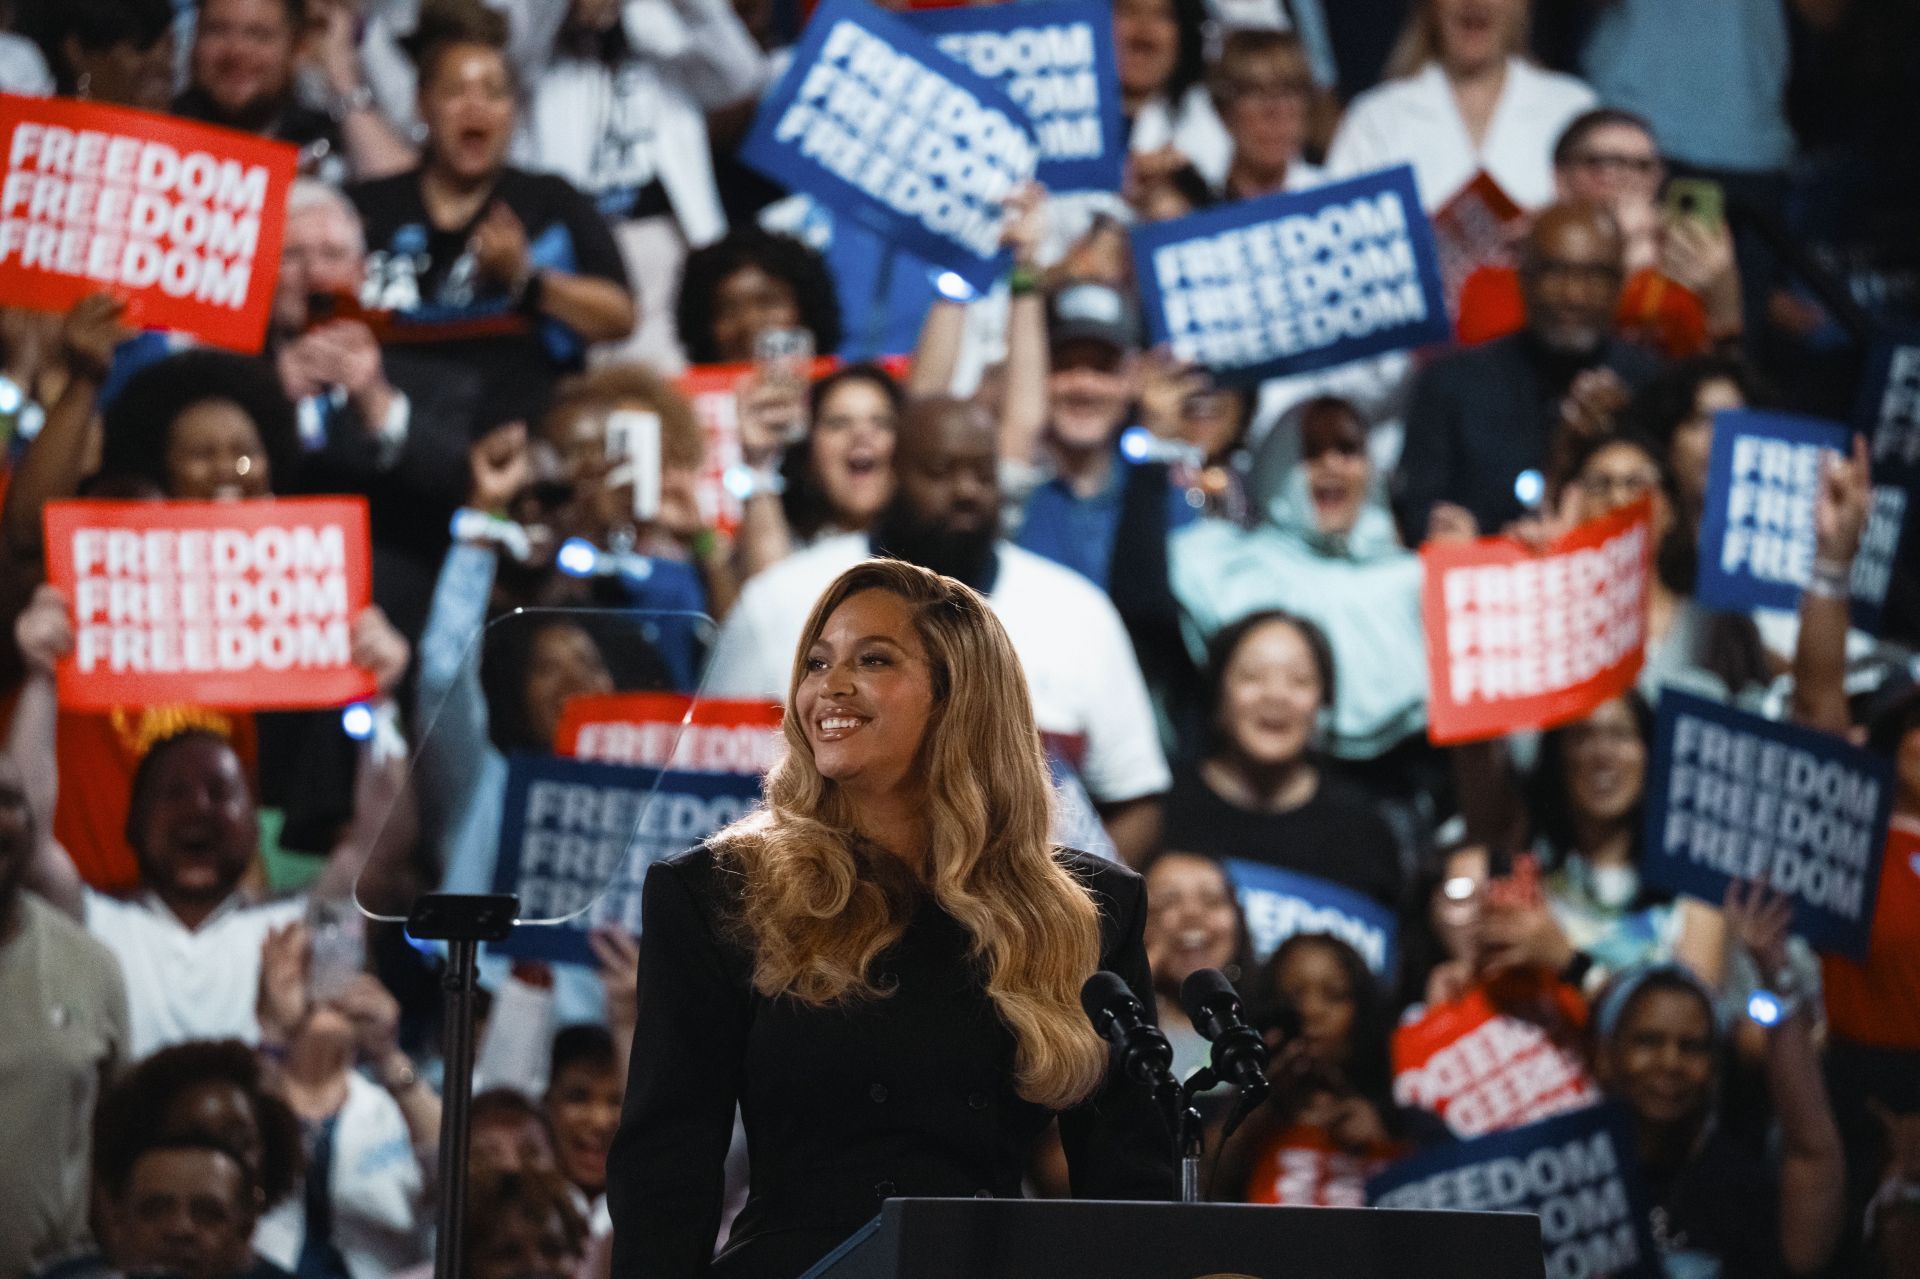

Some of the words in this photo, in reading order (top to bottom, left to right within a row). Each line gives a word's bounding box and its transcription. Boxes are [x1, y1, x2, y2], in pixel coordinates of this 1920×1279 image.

[820, 19, 1038, 183] FREEDOM
[10, 122, 269, 209] FREEDOM
[2, 172, 260, 256] FREEDOM
[1152, 189, 1405, 287] FREEDOM
[0, 220, 250, 310] FREEDOM
[1161, 238, 1417, 332] FREEDOM
[73, 523, 346, 577] FREEDOM
[75, 573, 348, 623] FREEDOM
[77, 621, 350, 674] FREEDOM
[526, 779, 762, 838] FREEDO
[1672, 712, 1881, 820] FREEDOM
[1668, 763, 1873, 870] FREEDOM
[1662, 811, 1864, 921] FREEDOM
